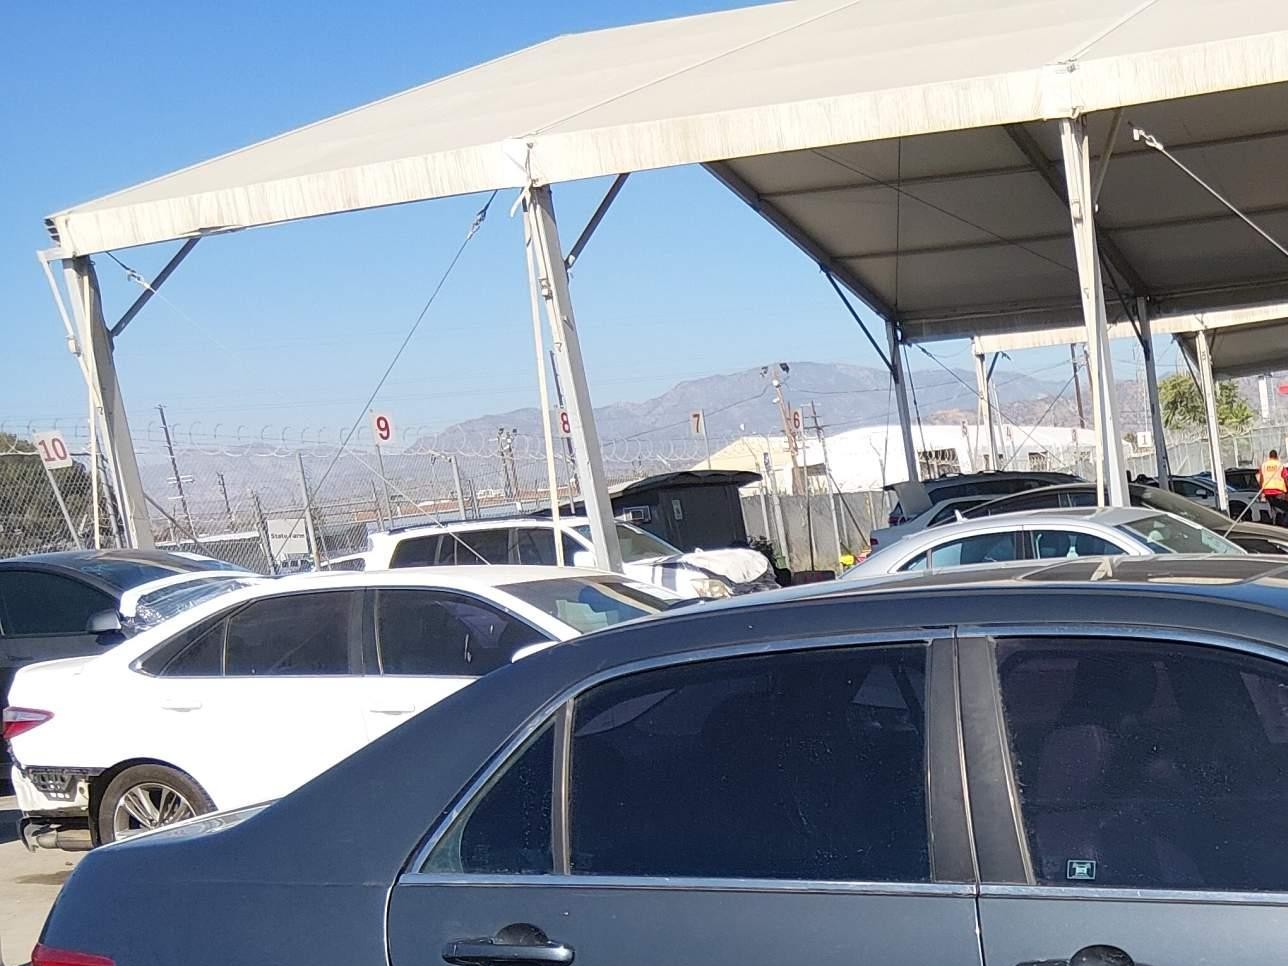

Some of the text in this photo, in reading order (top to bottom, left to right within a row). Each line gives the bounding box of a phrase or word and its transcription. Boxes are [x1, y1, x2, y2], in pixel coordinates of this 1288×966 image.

[376, 415, 391, 441] 9
[560, 411, 571, 434] 8
[691, 412, 701, 434] 7
[793, 410, 801, 430] 6
[38, 437, 68, 461] 10
